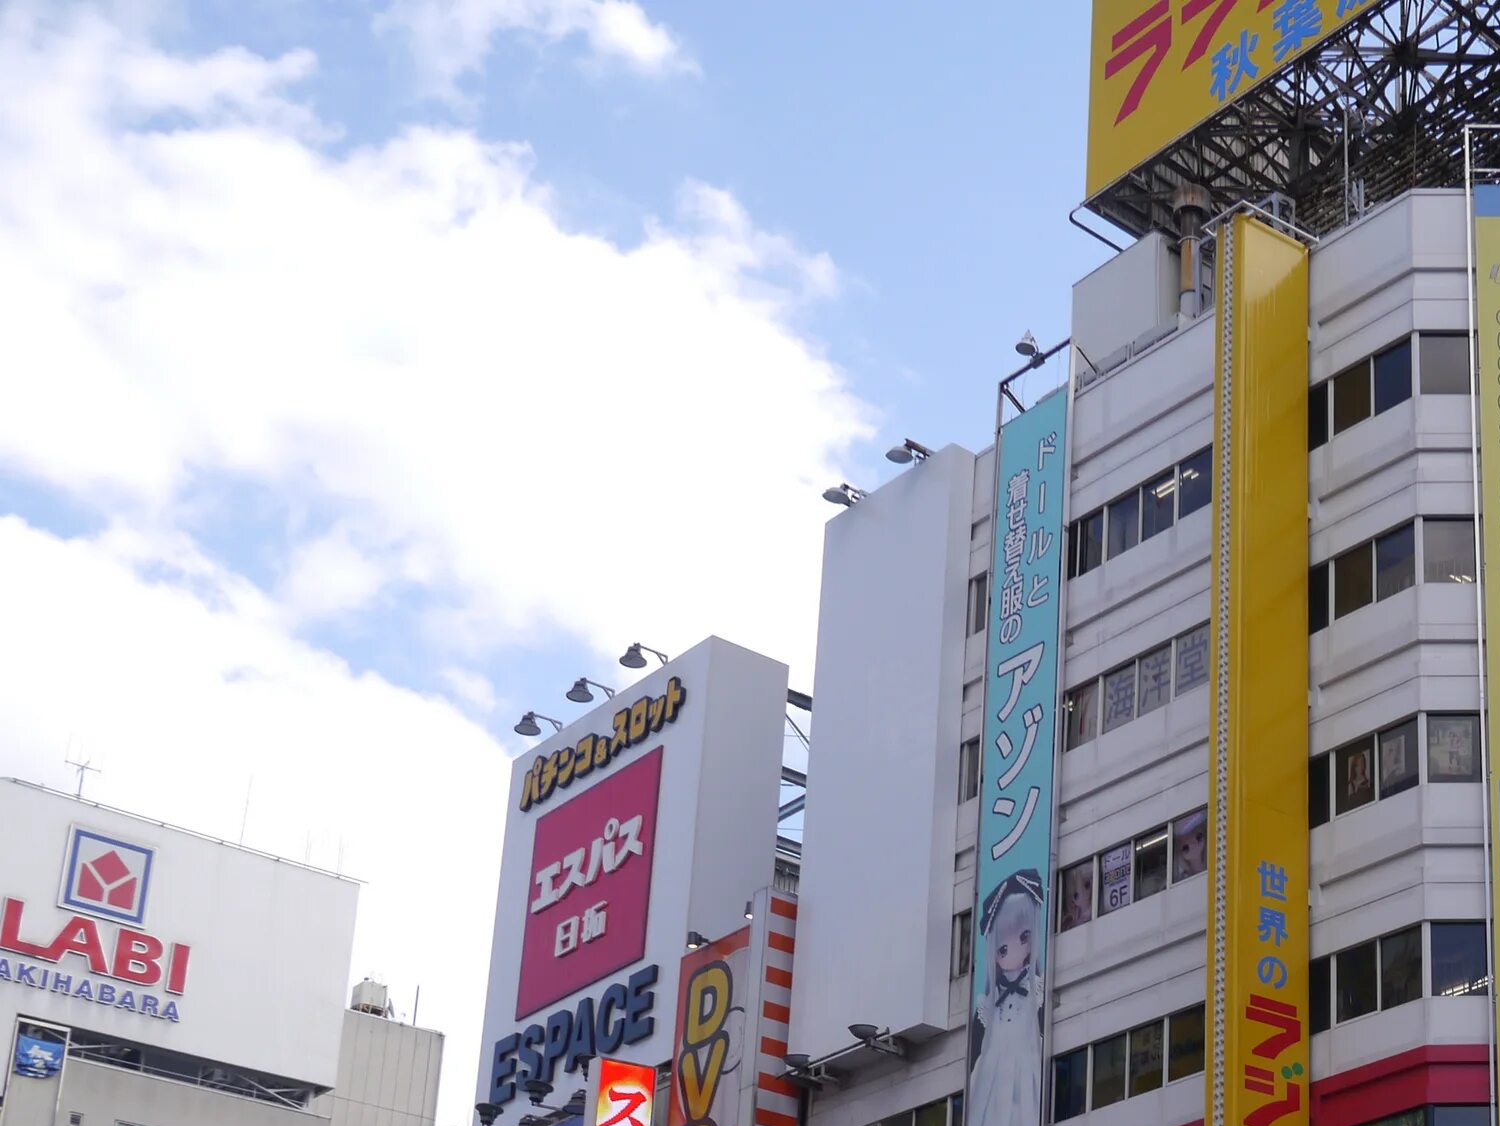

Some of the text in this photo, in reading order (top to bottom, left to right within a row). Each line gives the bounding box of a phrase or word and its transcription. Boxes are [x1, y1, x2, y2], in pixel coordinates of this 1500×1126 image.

[998, 466, 1030, 645] 着せ替え服の
[1024, 430, 1058, 608] ドールと
[990, 640, 1047, 862] アゾン
[531, 815, 644, 914] エスパス
[554, 901, 608, 957] 日拓
[1110, 886, 1128, 908] 6F
[1255, 860, 1289, 990] 世界の
[0, 897, 192, 995] LABI
[489, 964, 659, 1105] ESPACE
